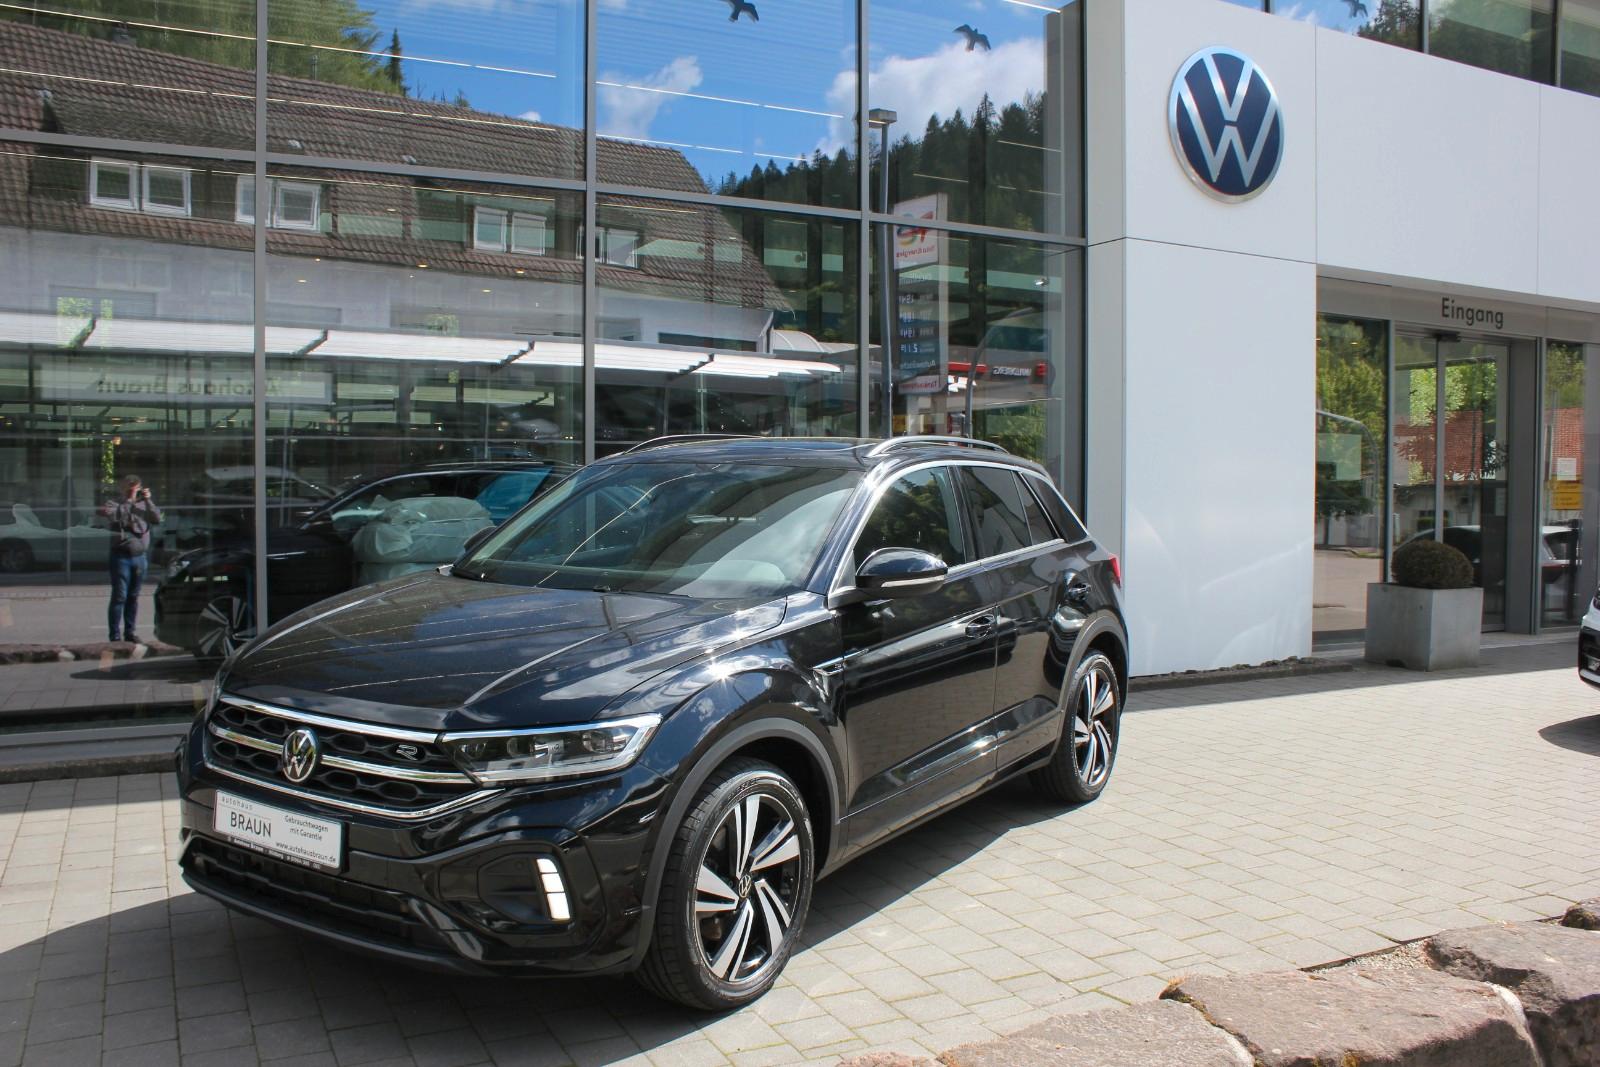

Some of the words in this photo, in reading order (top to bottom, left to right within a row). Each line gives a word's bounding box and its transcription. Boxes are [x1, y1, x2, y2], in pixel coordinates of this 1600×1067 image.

[1442, 296, 1504, 329] Eingang
[221, 796, 254, 811] autohaus
[230, 811, 272, 838] BRAUN
[284, 815, 329, 833] Gebrauchtwagen
[289, 827, 299, 836] mit
[300, 828, 323, 842] Garantie
[275, 841, 337, 863] www.autohausbraun.de
